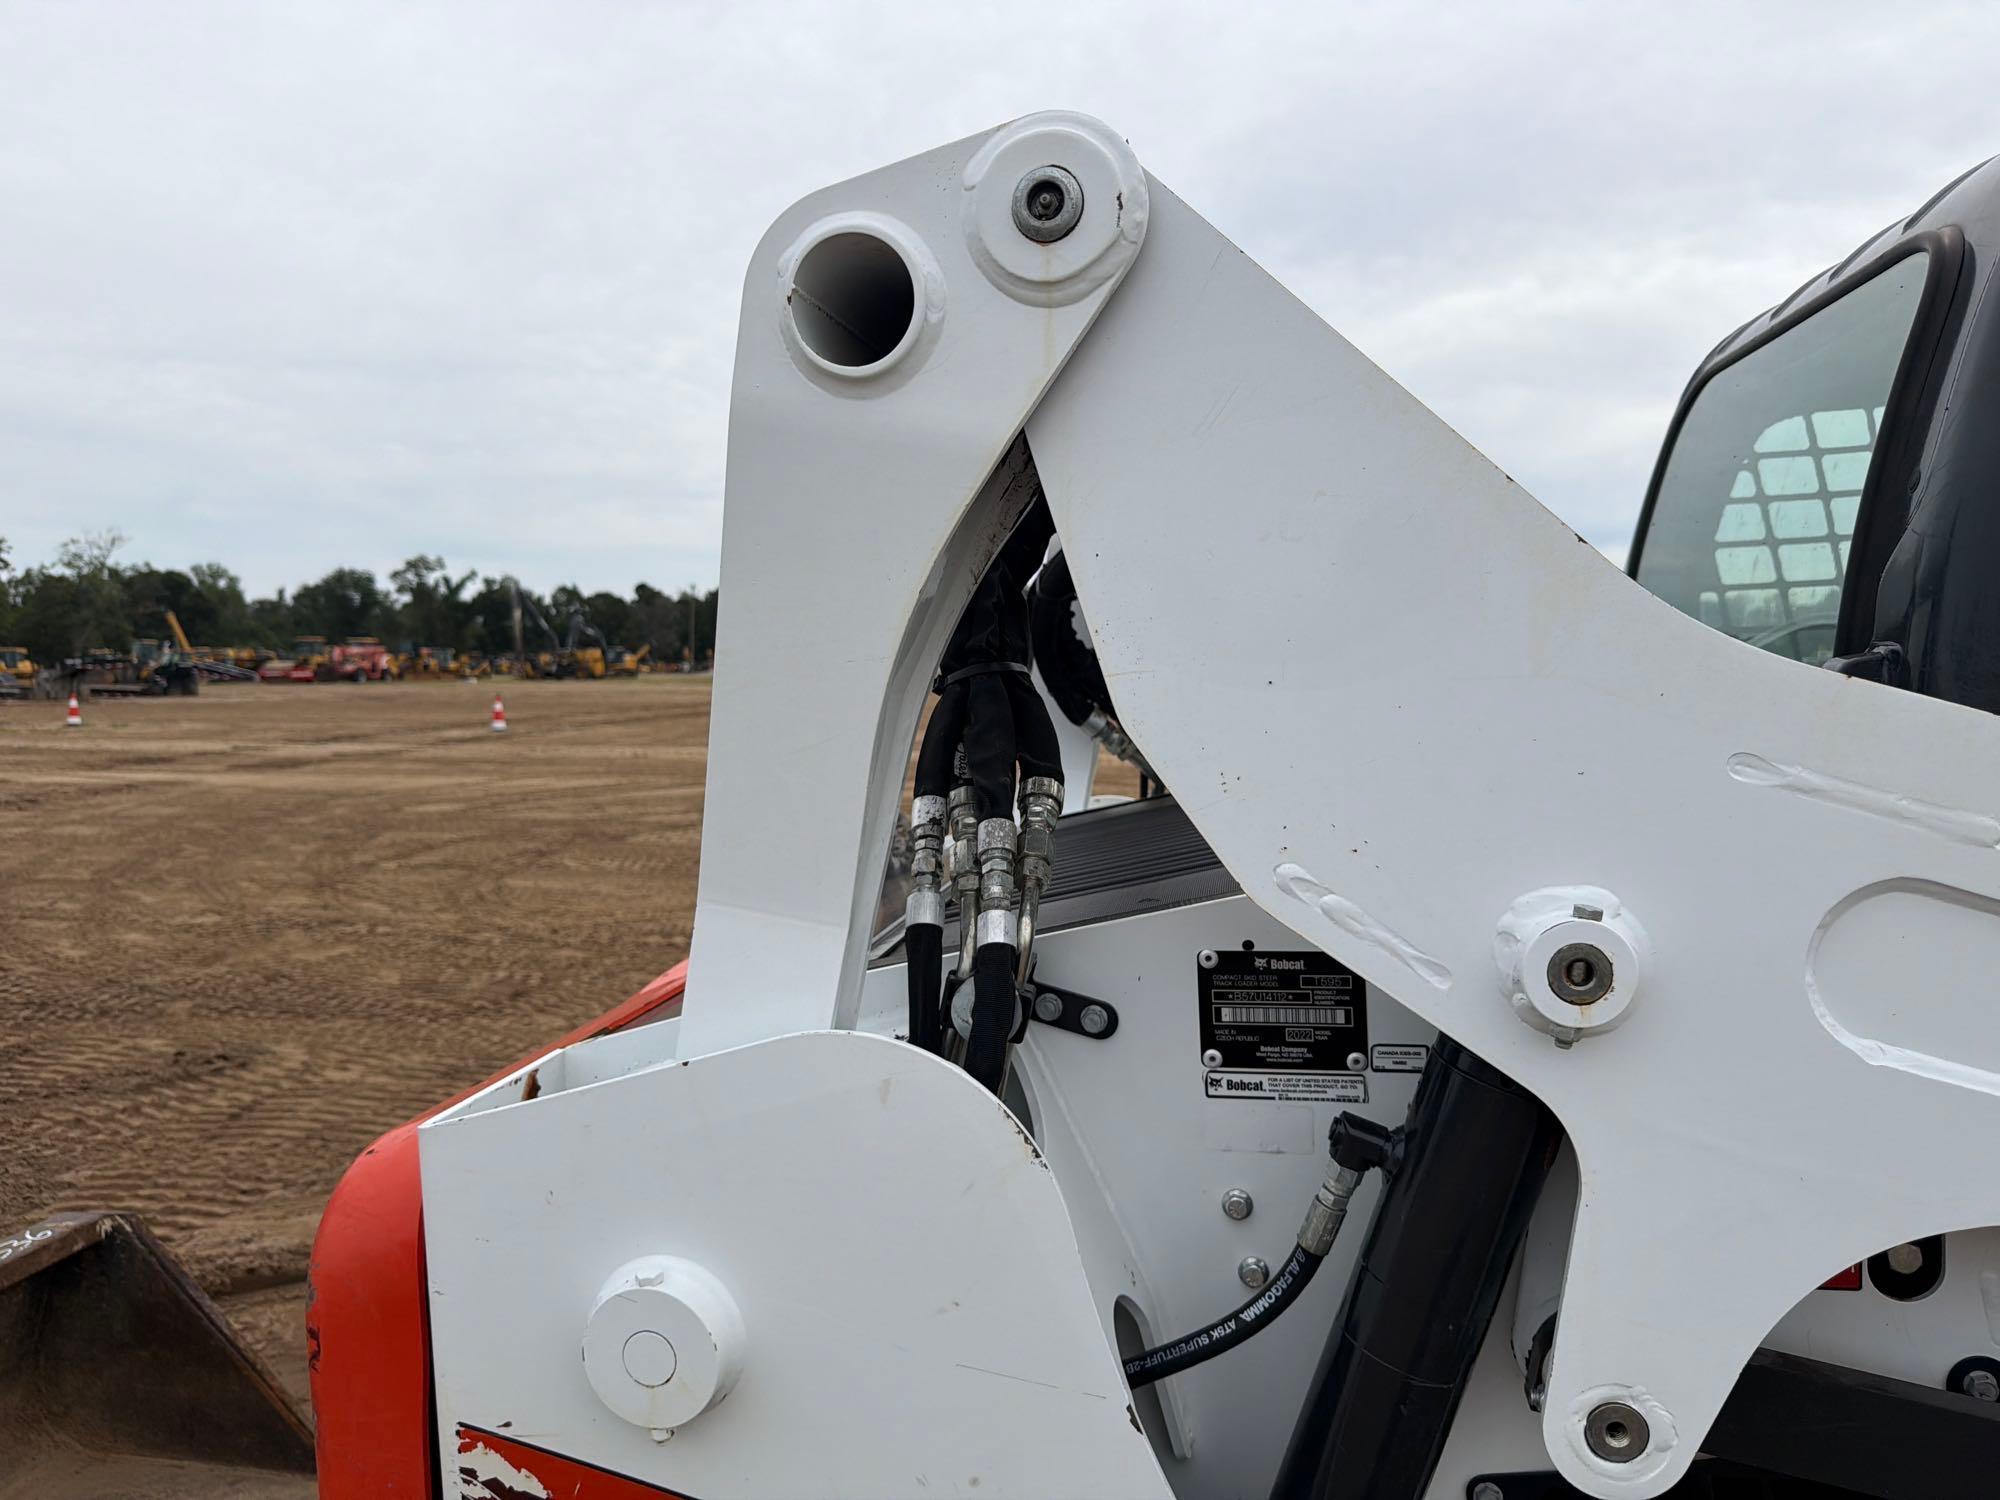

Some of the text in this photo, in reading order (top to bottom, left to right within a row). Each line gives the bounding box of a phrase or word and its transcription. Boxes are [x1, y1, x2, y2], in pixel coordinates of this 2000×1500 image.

[1270, 959, 1305, 970] Bobcat
[1314, 976, 1342, 987] T595
[1288, 1030, 1311, 1040] 2022
[1226, 1079, 1264, 1091] Bobcat
[1239, 1260, 1301, 1322] ALFAGOMMA
[1125, 1336, 1211, 1375] SUPERTUFF-2B
